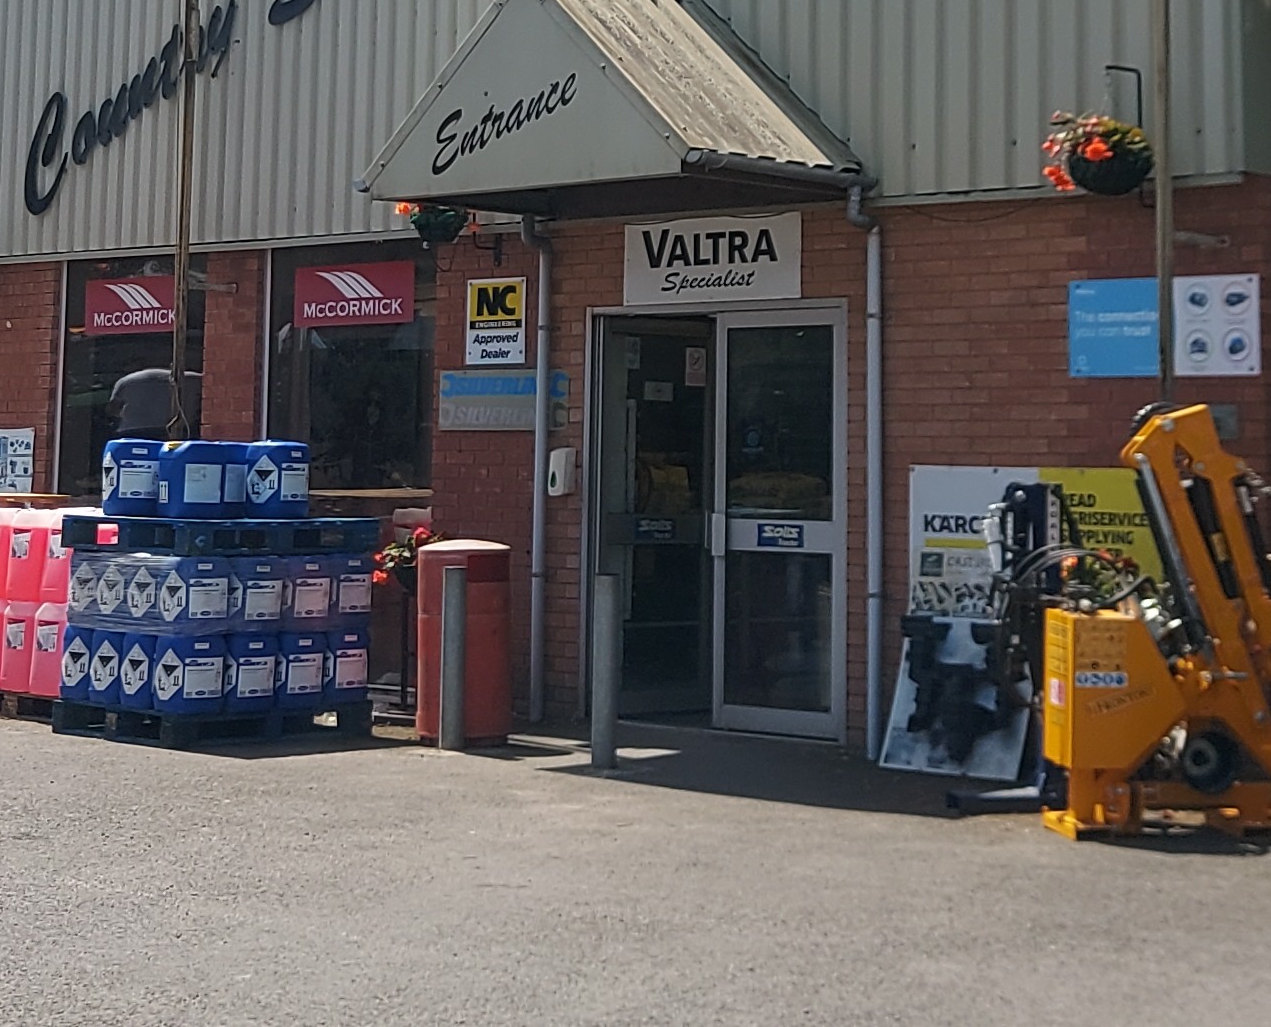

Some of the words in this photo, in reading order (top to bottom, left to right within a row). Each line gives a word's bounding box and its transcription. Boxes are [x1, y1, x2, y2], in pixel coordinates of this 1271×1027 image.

[432, 73, 578, 175] Entrance
[641, 228, 778, 269] VALTRA
[660, 268, 756, 295] Specialist
[303, 298, 403, 319] McCORMICK
[476, 285, 517, 317] NC
[472, 331, 520, 345] Approved
[480, 346, 511, 360] Dealer
